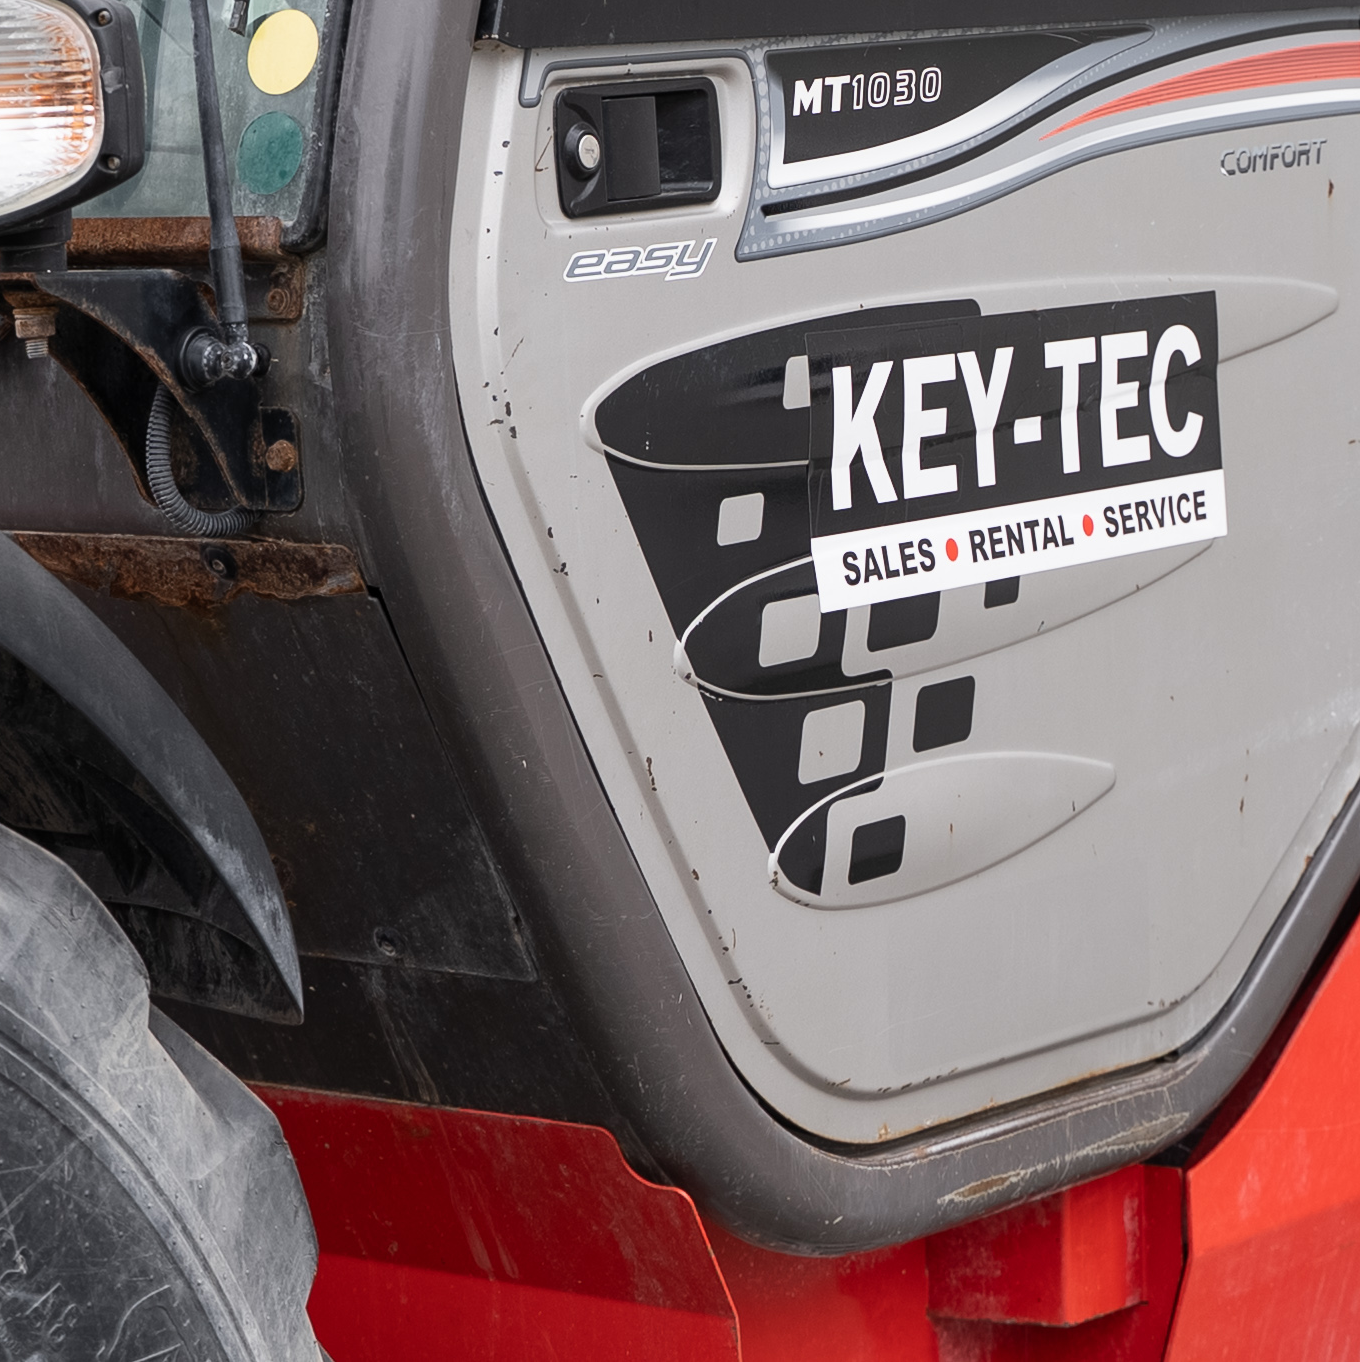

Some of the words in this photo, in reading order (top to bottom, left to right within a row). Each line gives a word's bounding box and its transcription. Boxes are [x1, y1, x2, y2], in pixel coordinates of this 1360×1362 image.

[792, 66, 942, 116] MT1030
[1220, 138, 1328, 177] COMFORT
[563, 237, 719, 283] easy
[830, 324, 1204, 511] KEY-TEC
[842, 537, 937, 587] SALES
[968, 514, 1075, 564] RENTAL
[1103, 489, 1208, 538] SERVICE
